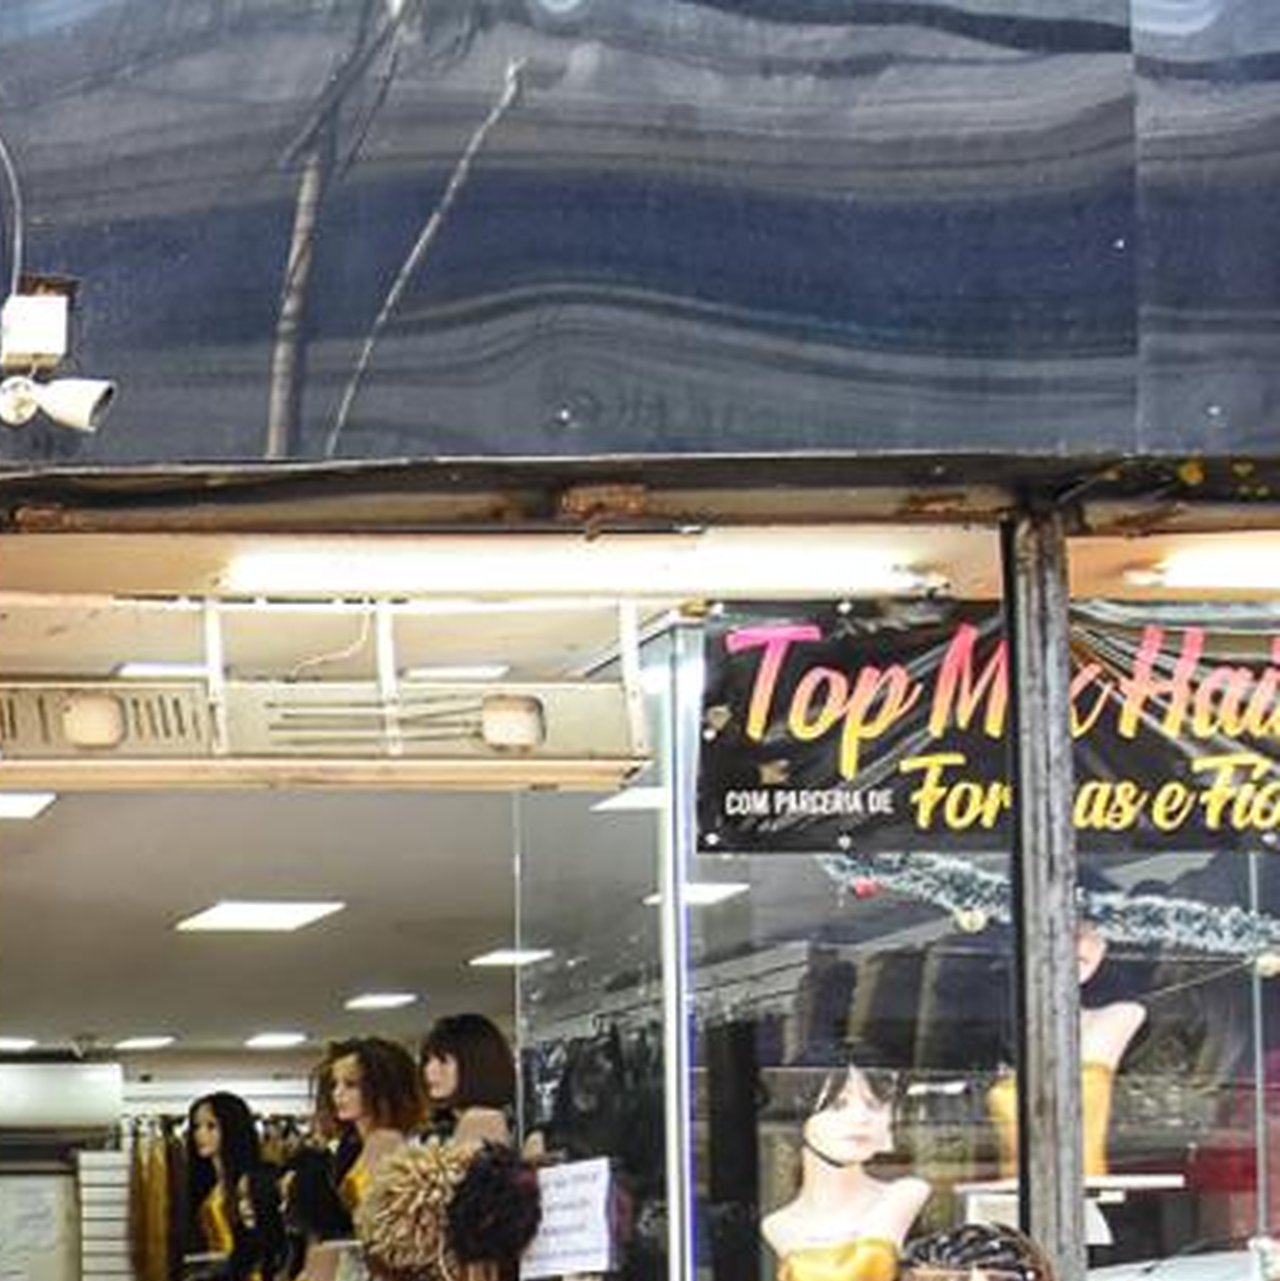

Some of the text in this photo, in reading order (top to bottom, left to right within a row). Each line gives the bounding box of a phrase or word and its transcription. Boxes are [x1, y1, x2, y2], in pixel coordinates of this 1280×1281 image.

[726, 625, 923, 781] Top
[1119, 624, 1280, 740] Hai
[725, 789, 770, 815] COM
[774, 789, 863, 815] PARCERIA
[868, 789, 894, 814] DE
[899, 753, 1148, 832] Foras
[1152, 781, 1196, 832] e
